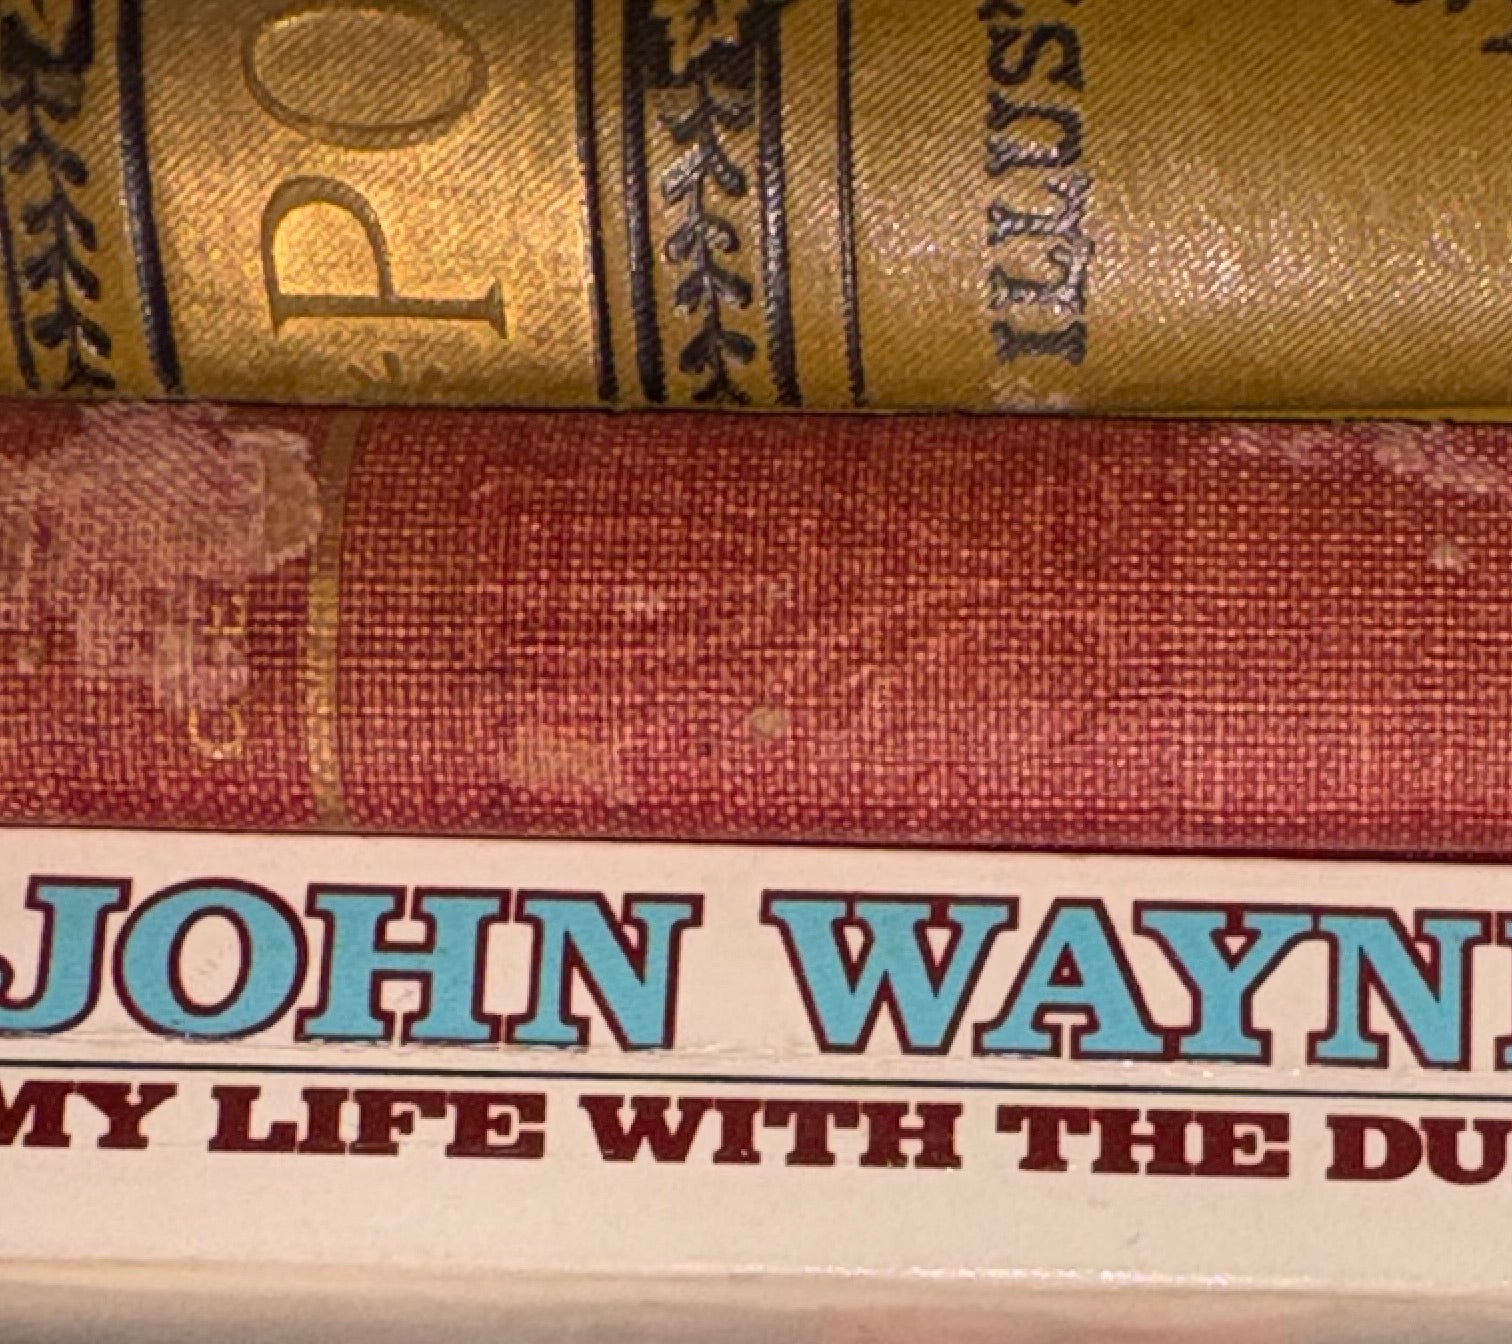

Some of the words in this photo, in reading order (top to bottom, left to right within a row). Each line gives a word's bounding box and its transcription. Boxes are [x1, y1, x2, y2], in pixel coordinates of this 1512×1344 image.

[0, 875, 704, 1052] JOHN
[0, 1080, 177, 1150] MY
[208, 1086, 546, 1158] LIFE
[579, 1094, 962, 1168] WITH
[996, 1104, 1290, 1179] THE
